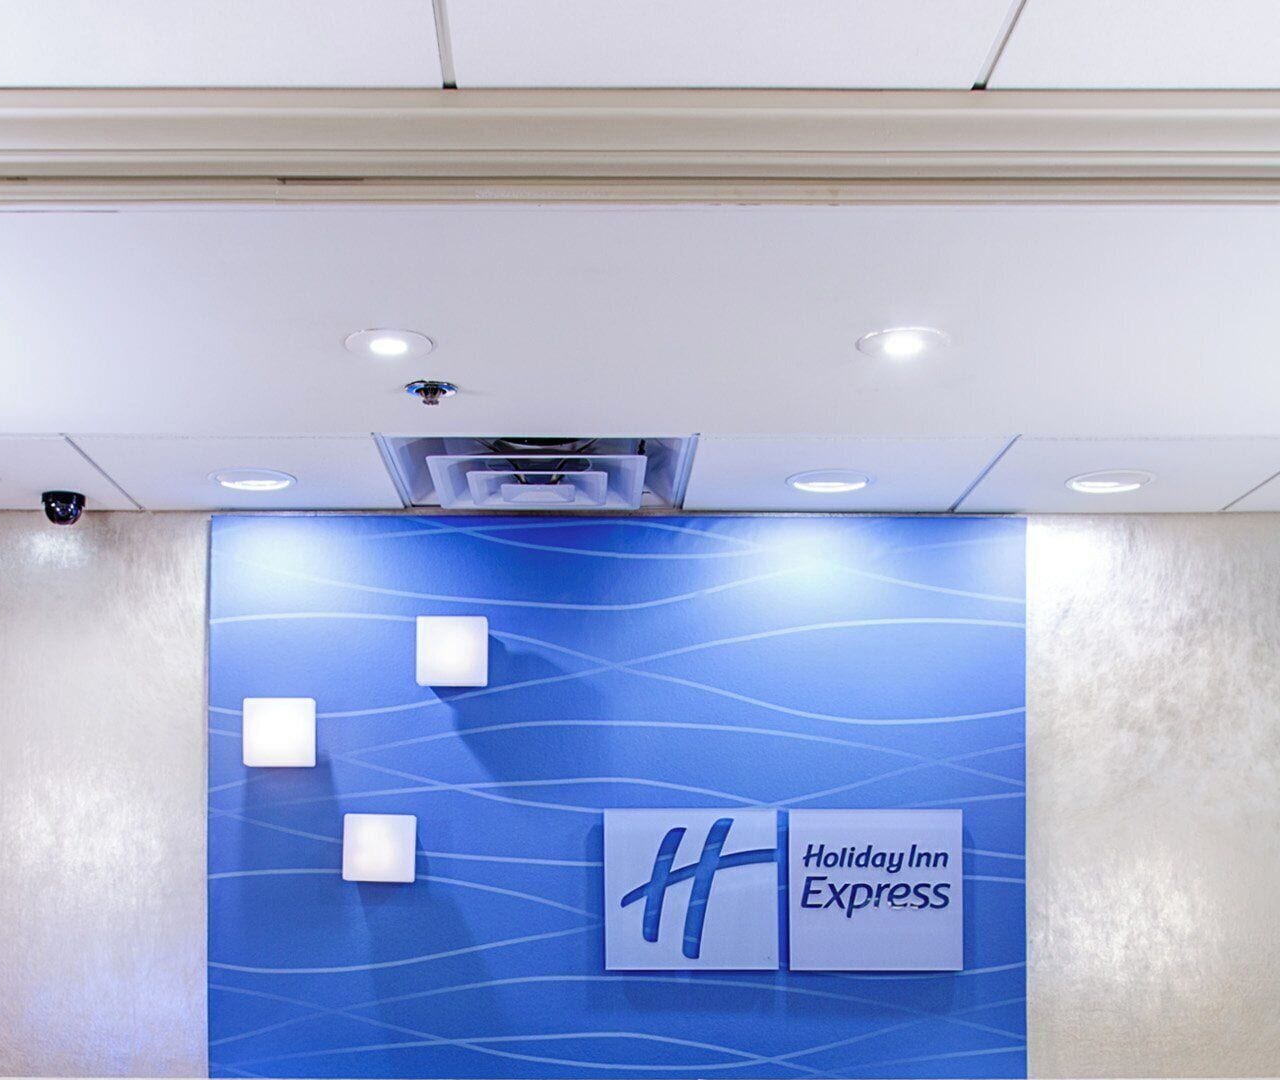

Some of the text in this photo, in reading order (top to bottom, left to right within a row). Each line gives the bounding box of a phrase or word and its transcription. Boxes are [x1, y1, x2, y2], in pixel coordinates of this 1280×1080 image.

[803, 844, 949, 873] Holiday Inn
[800, 876, 951, 919] Express
